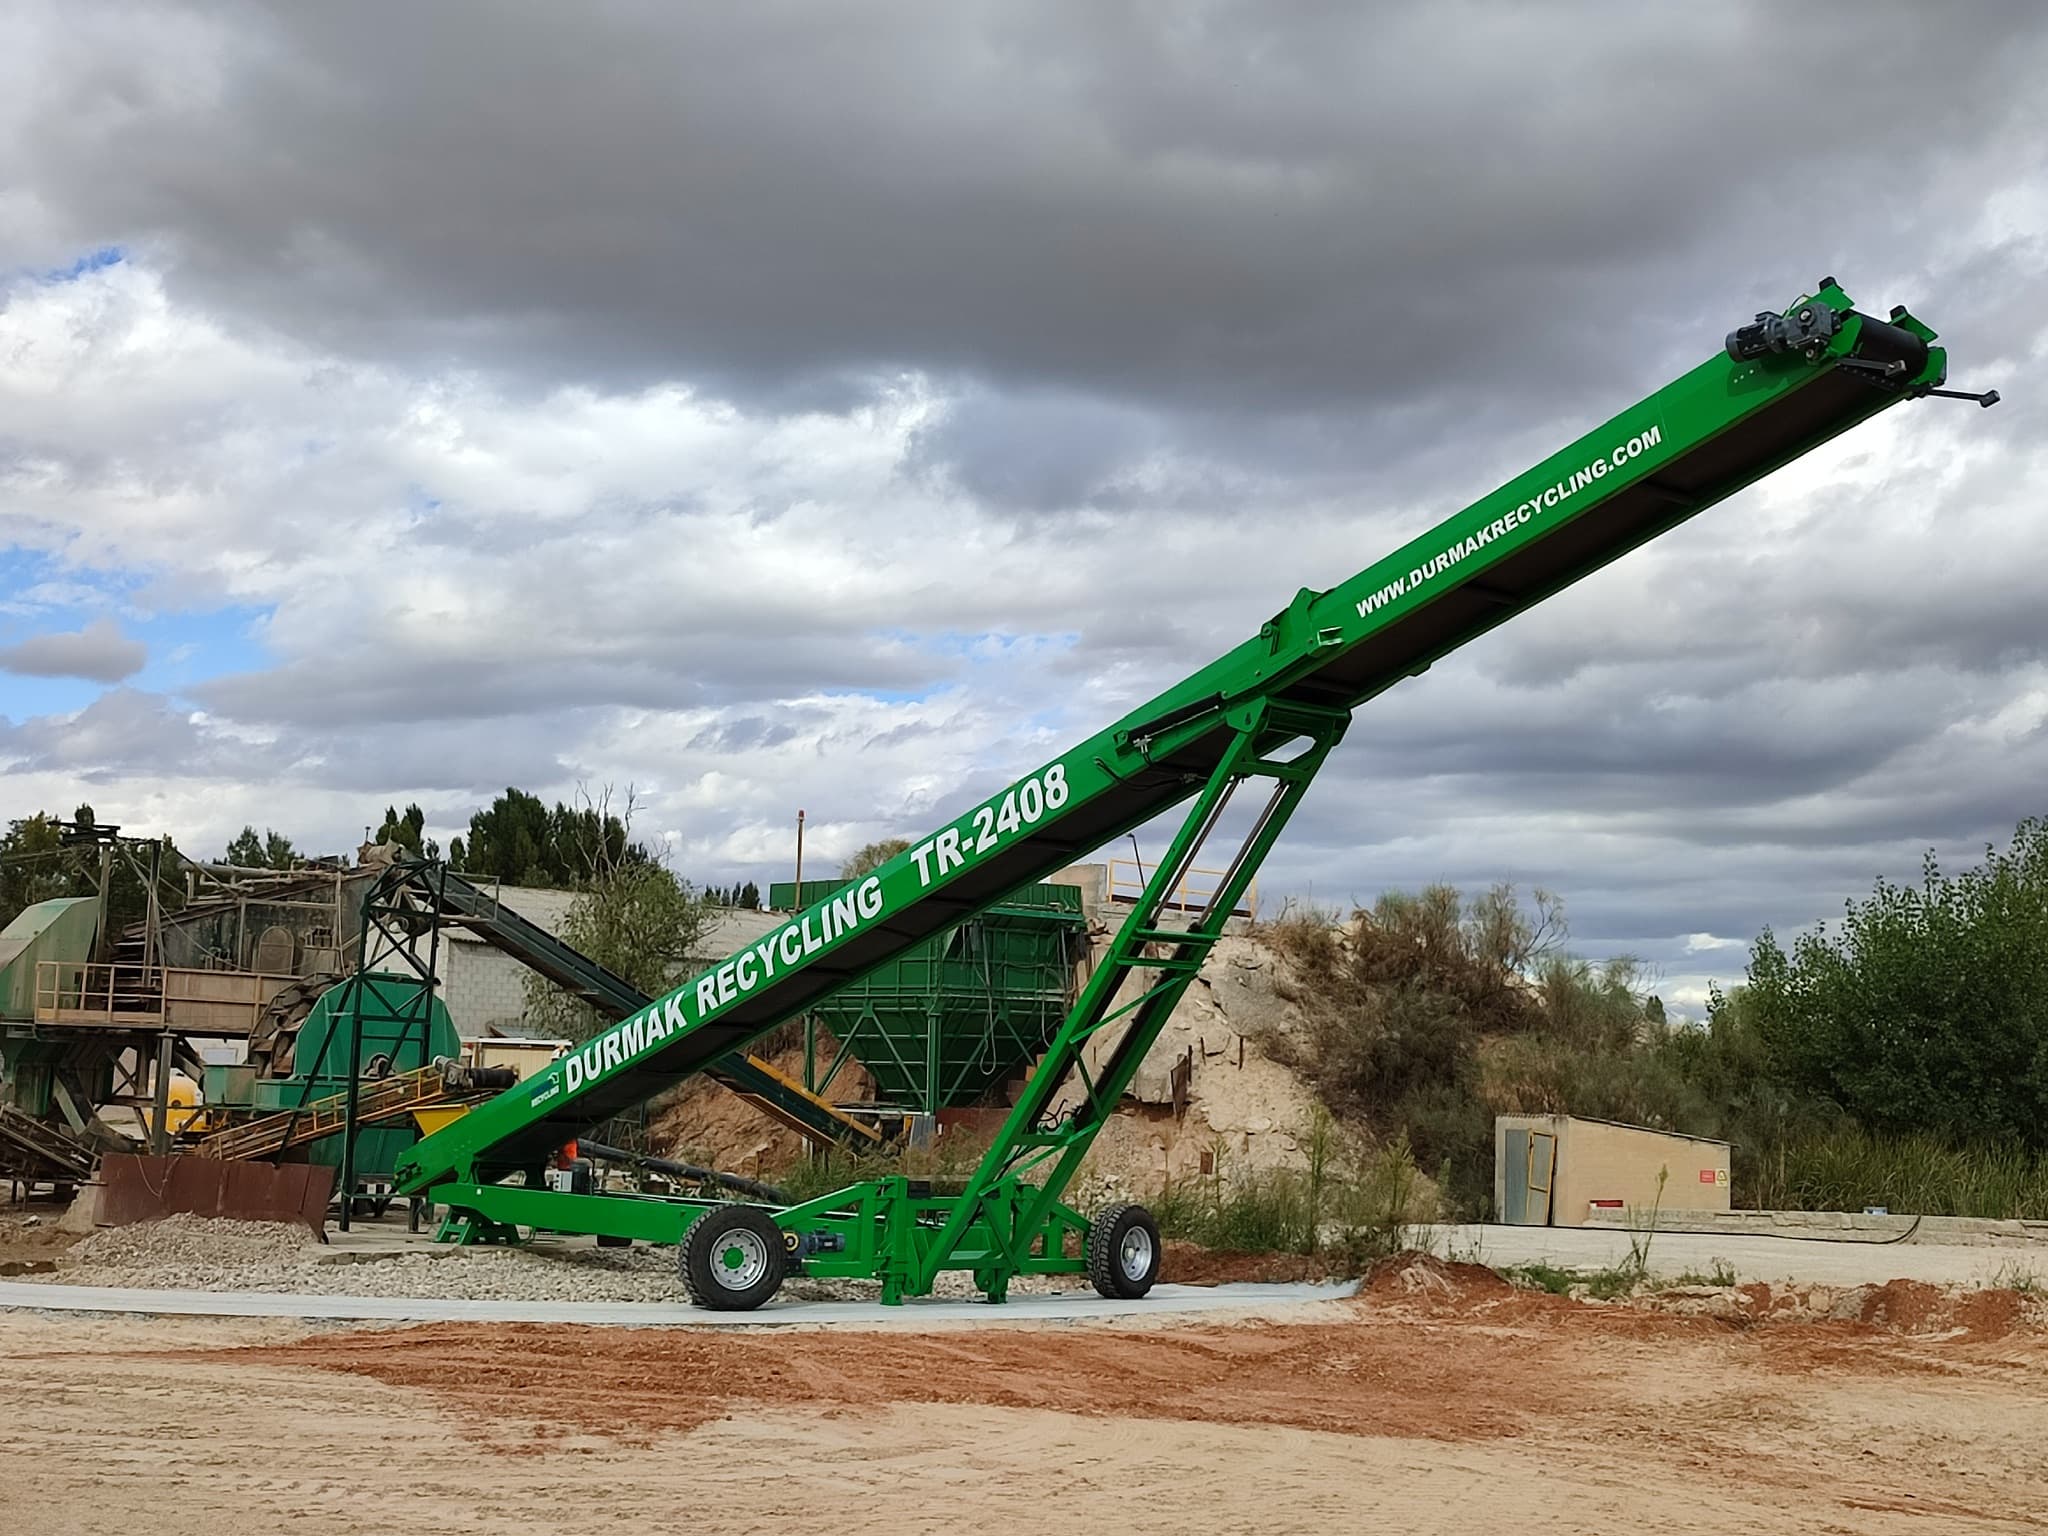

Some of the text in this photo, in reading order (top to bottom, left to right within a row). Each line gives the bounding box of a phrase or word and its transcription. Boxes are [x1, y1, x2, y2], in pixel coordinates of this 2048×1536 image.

[1356, 425, 1662, 618] WWW.DURMAKRECYCLING.COM
[565, 763, 1069, 1094] DURMAK RECYCLING TR-2408
